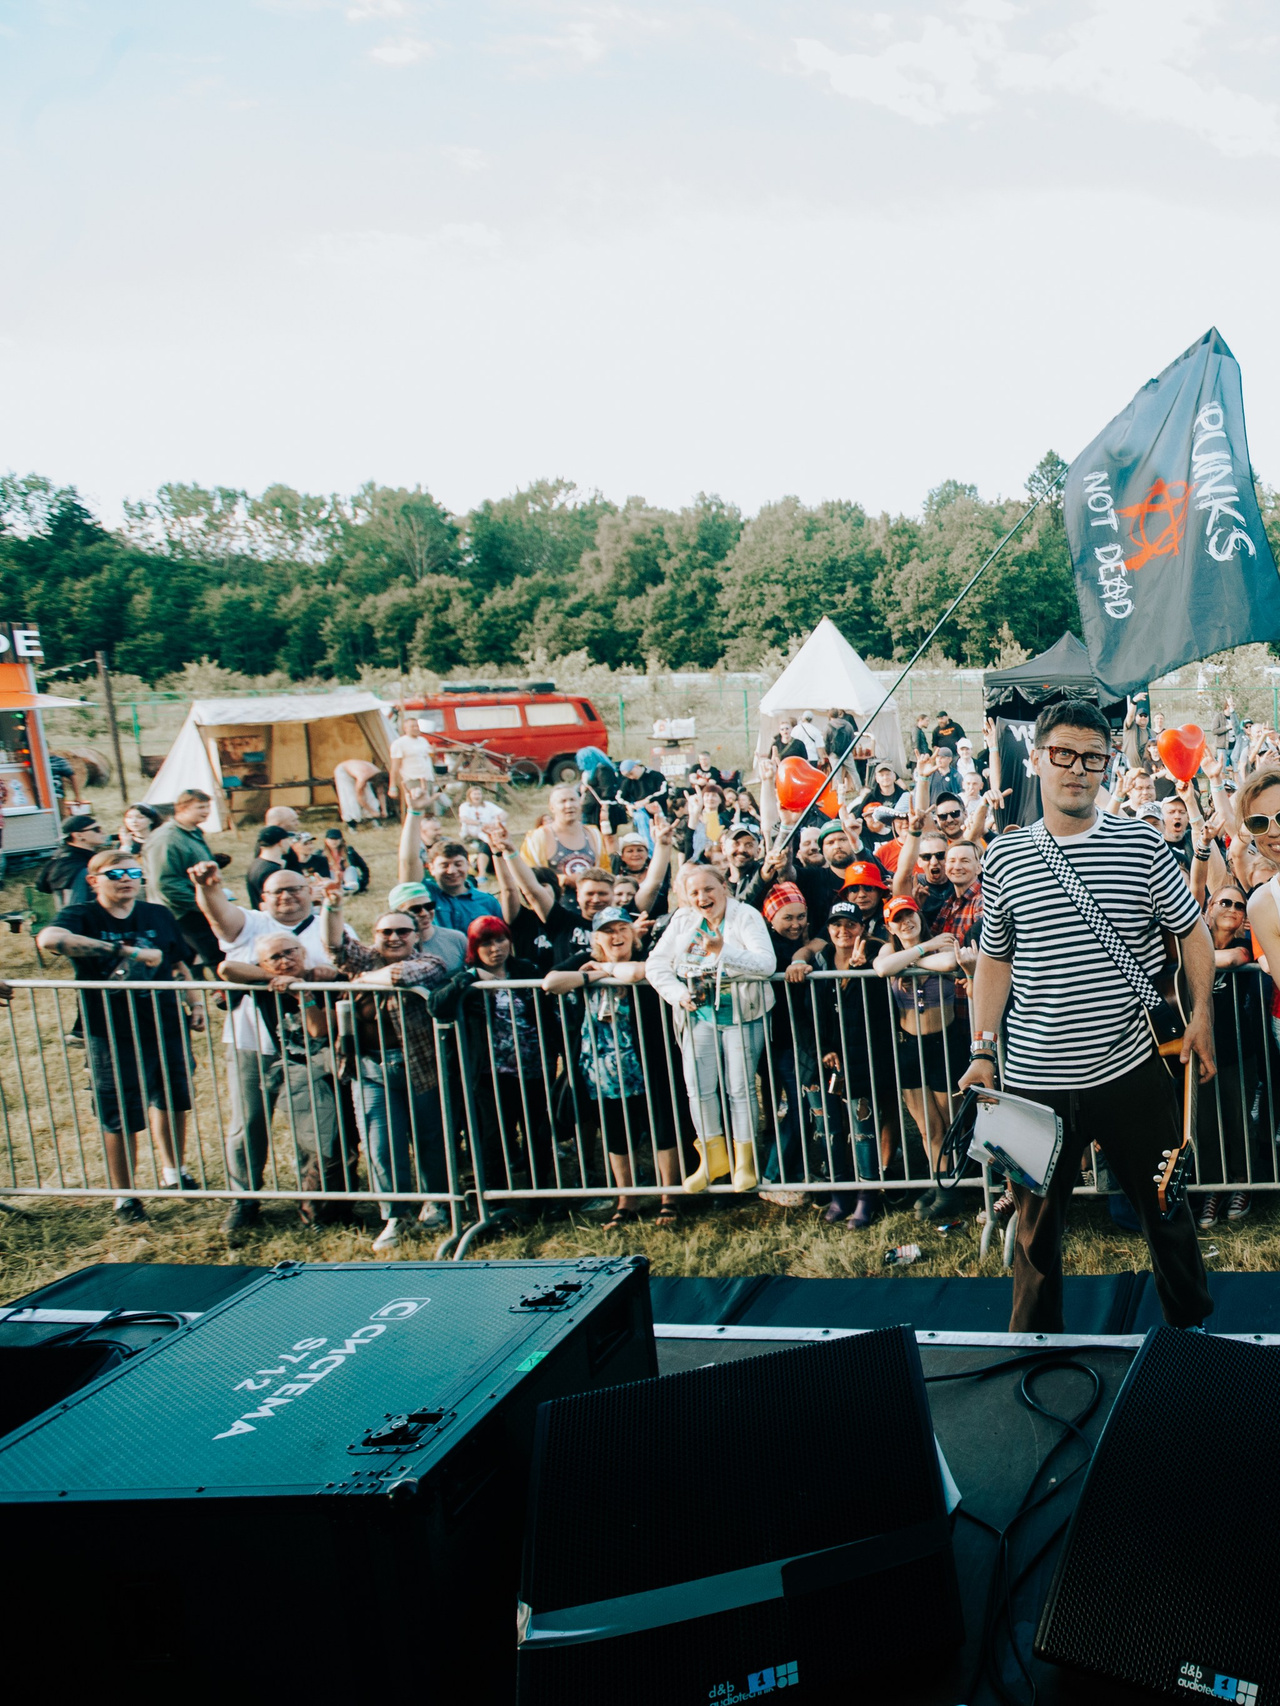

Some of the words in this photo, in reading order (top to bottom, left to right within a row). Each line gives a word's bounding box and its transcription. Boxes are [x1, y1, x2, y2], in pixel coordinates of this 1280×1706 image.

[1083, 471, 1120, 533] NOT
[1191, 400, 1257, 562] PUNKS
[1094, 542, 1137, 620] DEAD
[831, 901, 856, 914] FCSM
[212, 1324, 387, 1440] СИСТЕМА
[232, 1337, 328, 1391] S712
[708, 1680, 735, 1699] d&b
[1180, 1661, 1203, 1680] d&b
